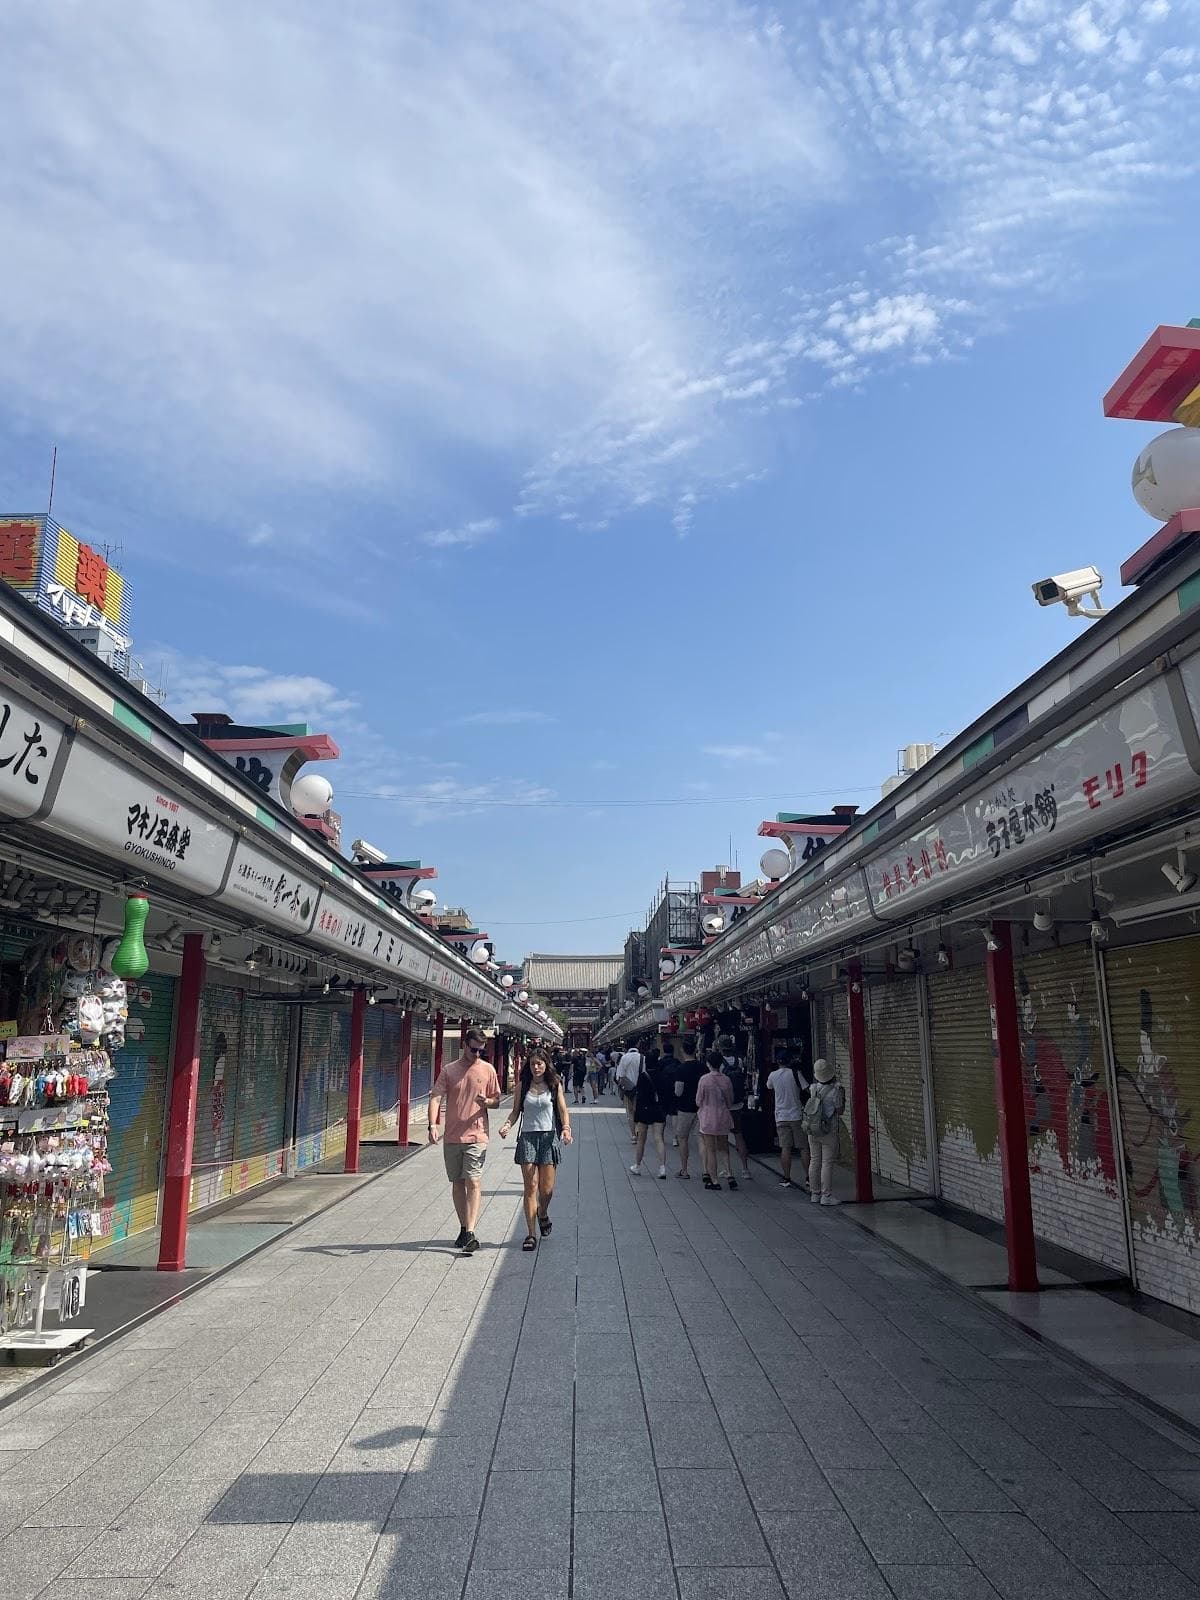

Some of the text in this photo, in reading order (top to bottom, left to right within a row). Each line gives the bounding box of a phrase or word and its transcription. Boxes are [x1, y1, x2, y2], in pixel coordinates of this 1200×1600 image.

[76, 542, 109, 612] 薬
[1082, 750, 1149, 810] モリタ
[156, 795, 169, 808] since
[124, 841, 176, 870] GYOKUSHINDO
[373, 930, 403, 966] スミレ
